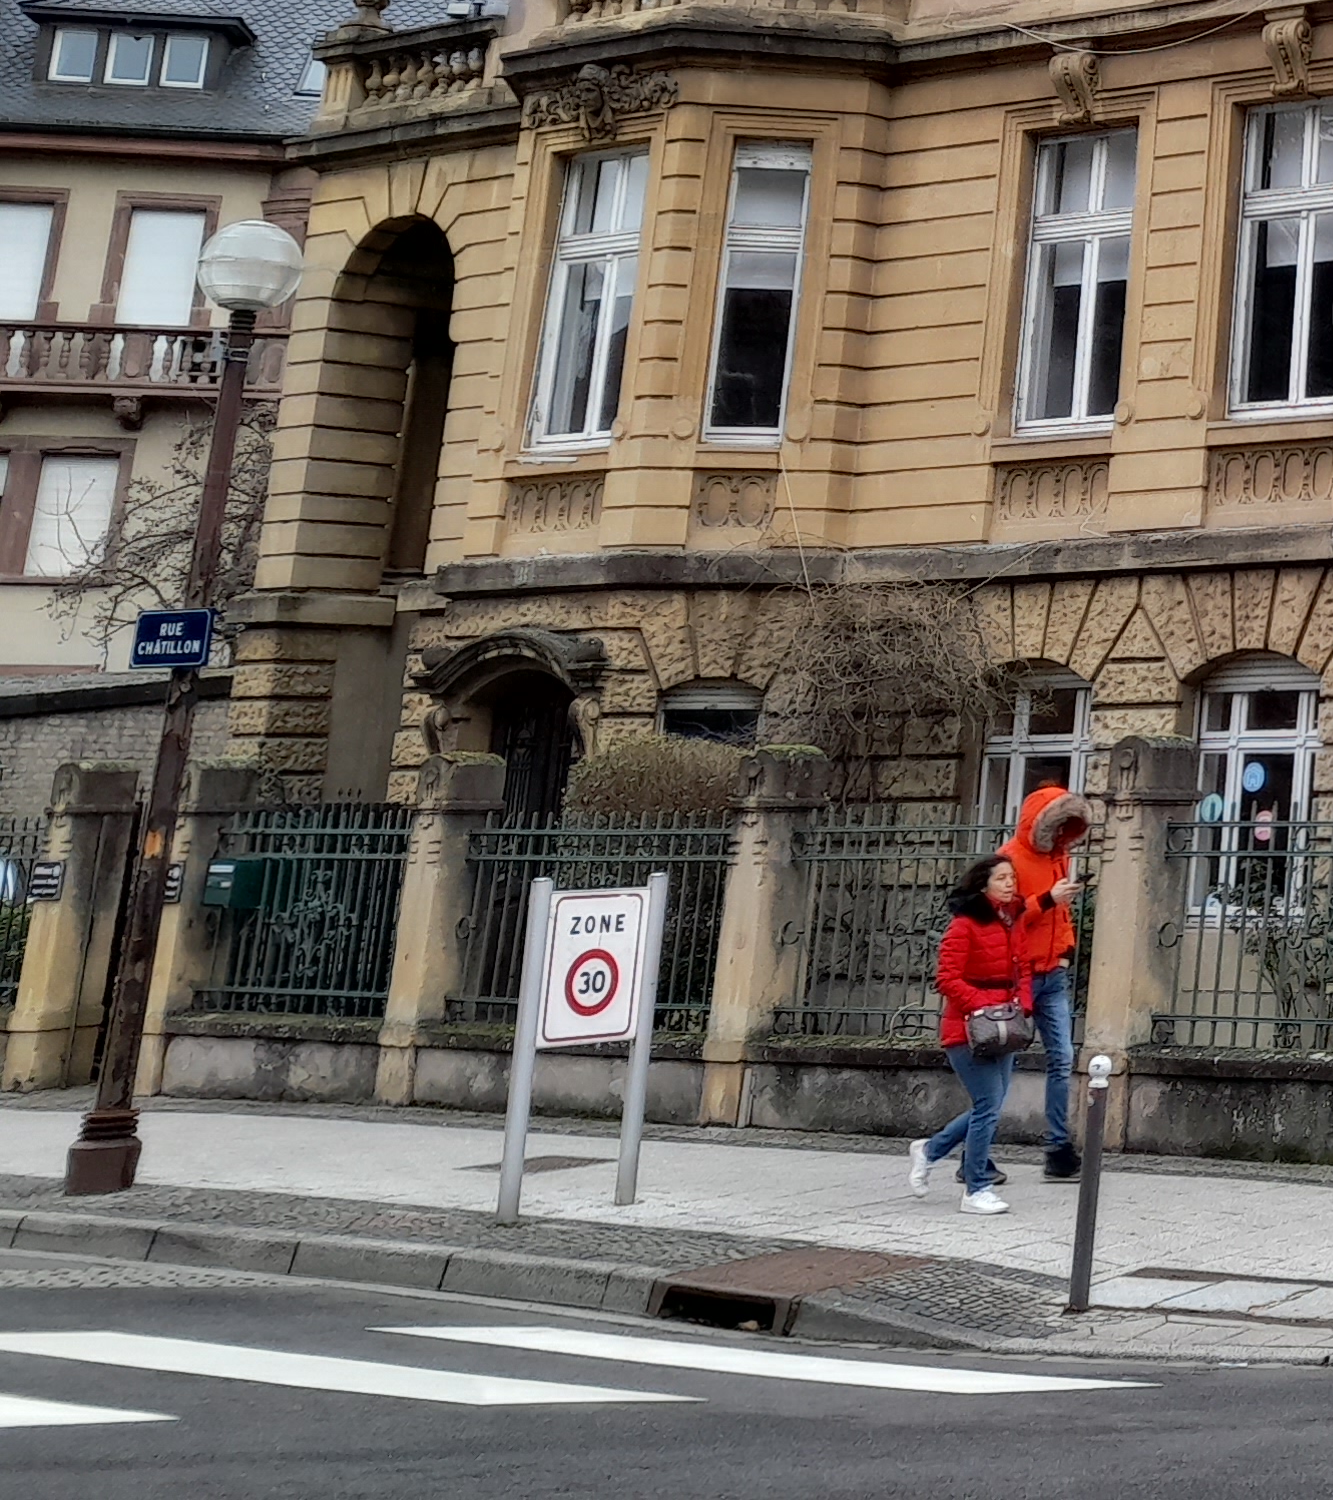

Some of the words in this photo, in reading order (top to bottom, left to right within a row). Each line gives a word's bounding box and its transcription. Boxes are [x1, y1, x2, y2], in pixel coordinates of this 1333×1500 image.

[159, 622, 185, 636] RUE
[137, 639, 200, 655] CHÂTILLON
[570, 914, 625, 935] ZONE
[578, 971, 606, 994] 30
